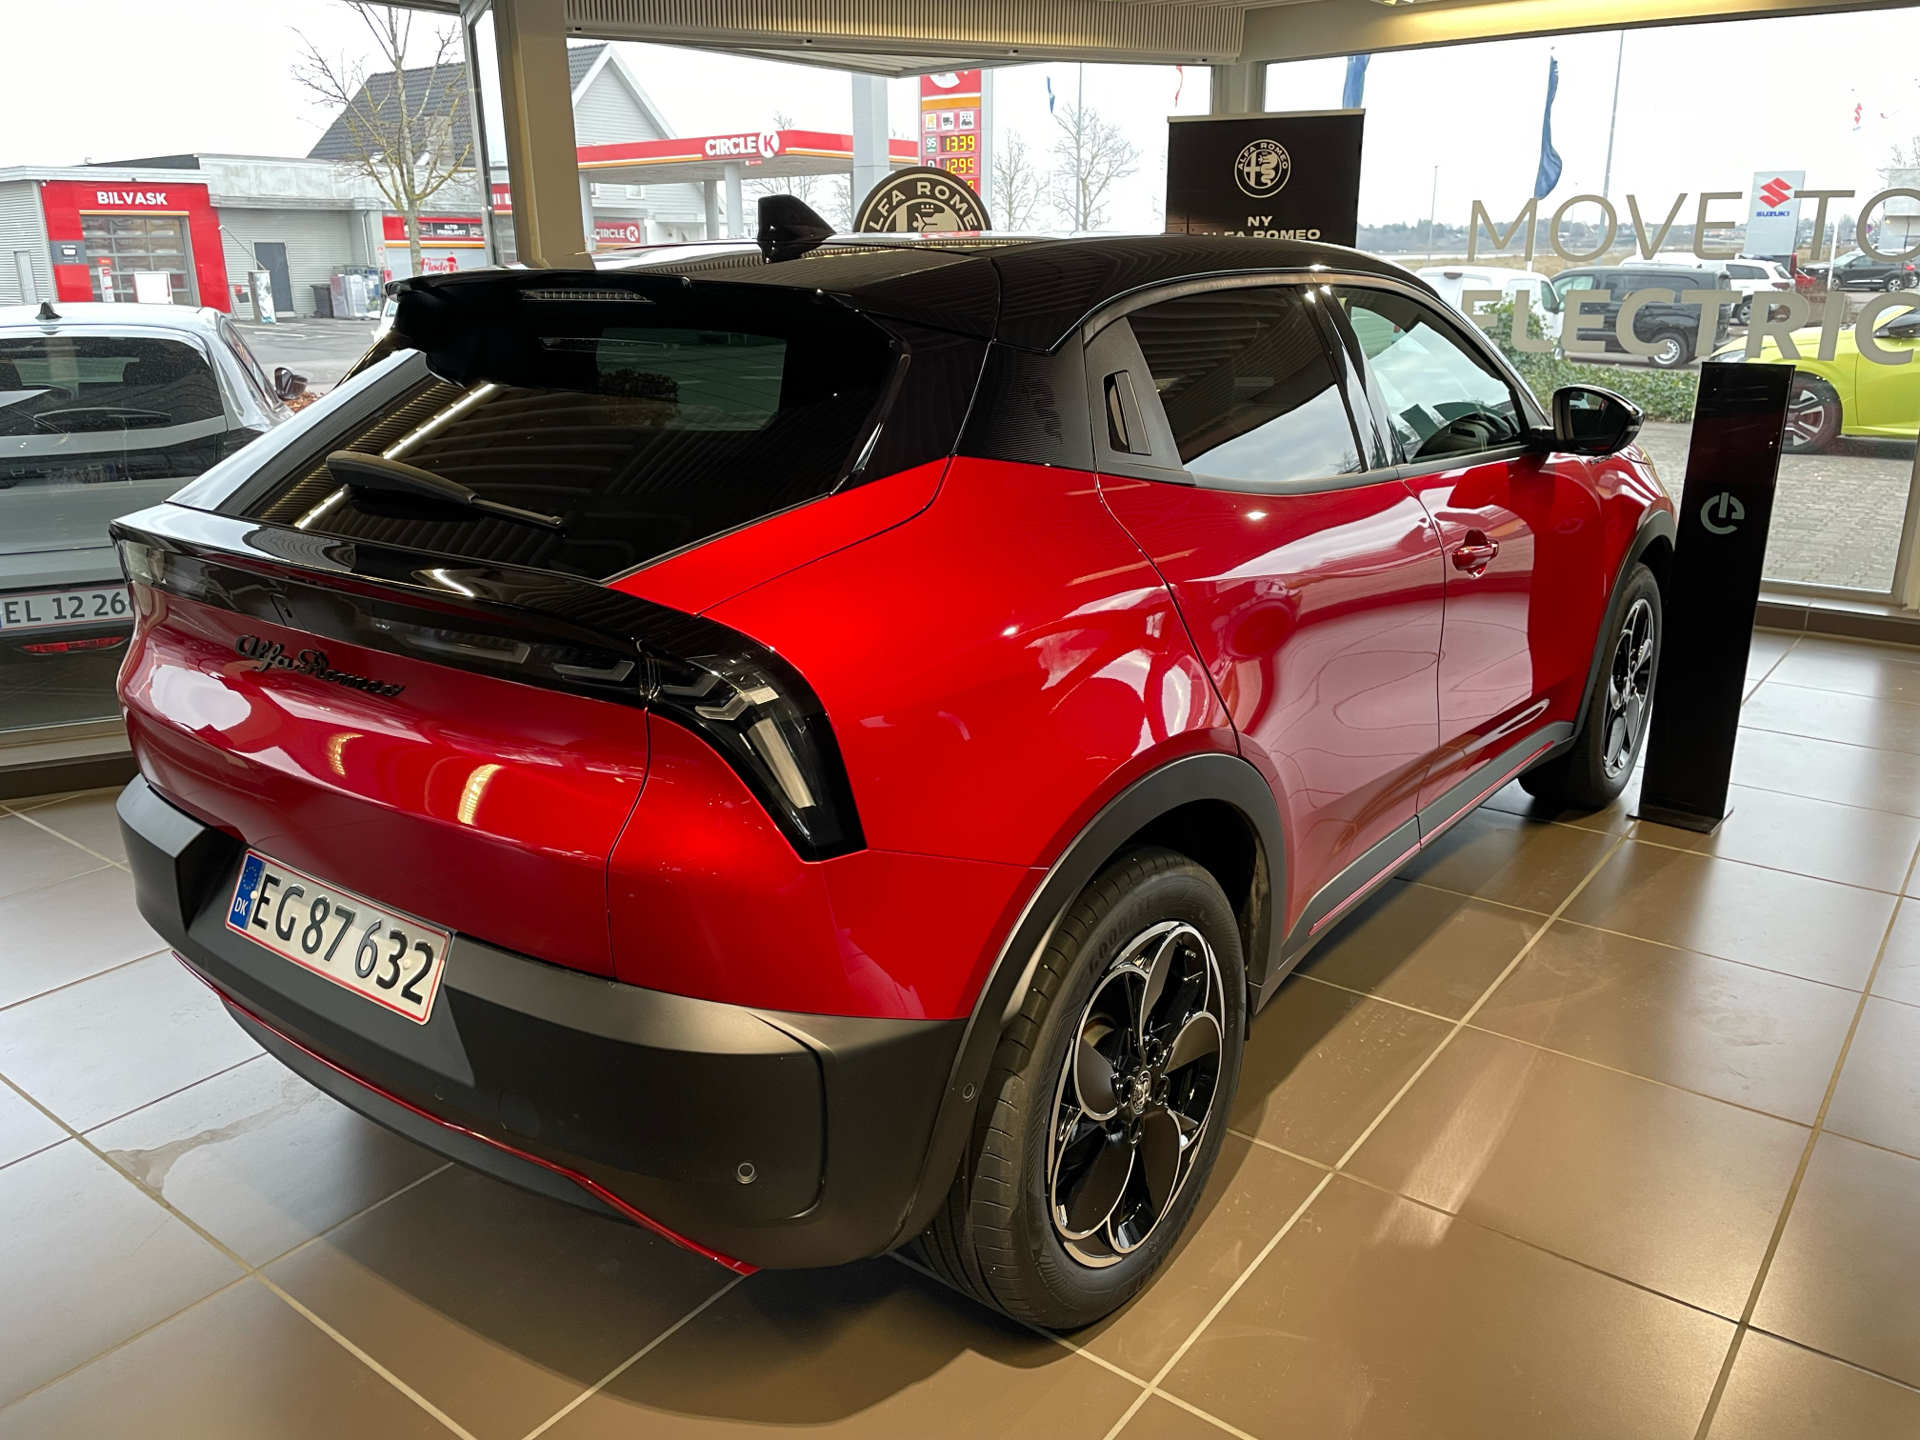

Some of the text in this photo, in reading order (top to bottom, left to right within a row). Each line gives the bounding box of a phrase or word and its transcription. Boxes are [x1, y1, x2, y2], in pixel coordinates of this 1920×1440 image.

[704, 136, 758, 156] CIRCLE
[945, 135, 975, 152] 13.39
[1238, 142, 1289, 170] ALFA ROMEO
[96, 191, 168, 206] BILVASK
[869, 181, 979, 231] LFA ROME
[594, 228, 626, 239] CIRCLE
[1247, 215, 1273, 227] NY
[1252, 229, 1321, 240] ROMEO
[1467, 188, 1920, 262] MOVE TO
[1460, 288, 1920, 365] ELECTRIC
[4, 600, 42, 624] EL
[52, 596, 86, 620] 12
[234, 634, 406, 697] Alfa Romeo
[234, 896, 249, 916] DK
[354, 918, 434, 1006] 632
